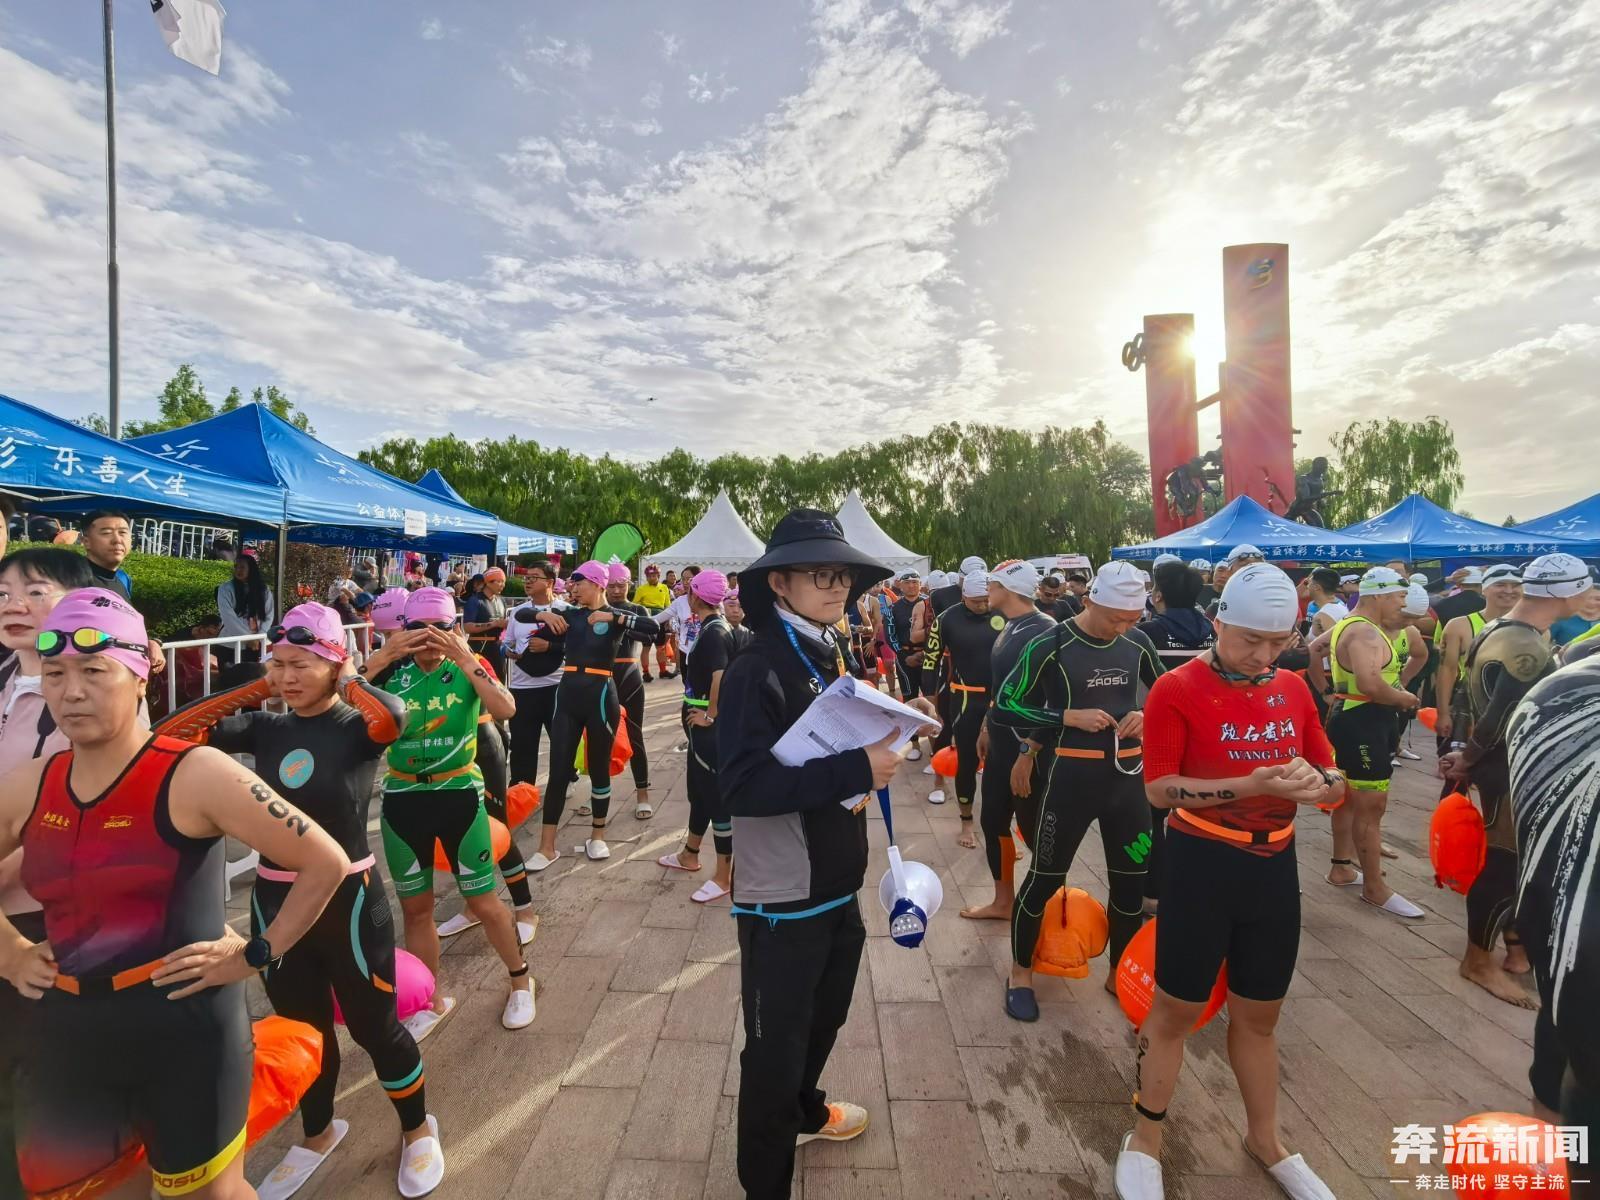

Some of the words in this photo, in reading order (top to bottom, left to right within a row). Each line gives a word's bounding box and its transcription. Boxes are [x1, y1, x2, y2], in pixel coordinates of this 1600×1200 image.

[53, 446, 190, 497] 乐善人生
[1314, 545, 1364, 558] 乐善人生
[1457, 543, 1504, 552] 公益体彩
[1513, 543, 1560, 553] 乐善人生
[923, 619, 941, 670] BASIC
[1087, 676, 1128, 688] ZAOSU
[1228, 750, 1271, 759] WANG
